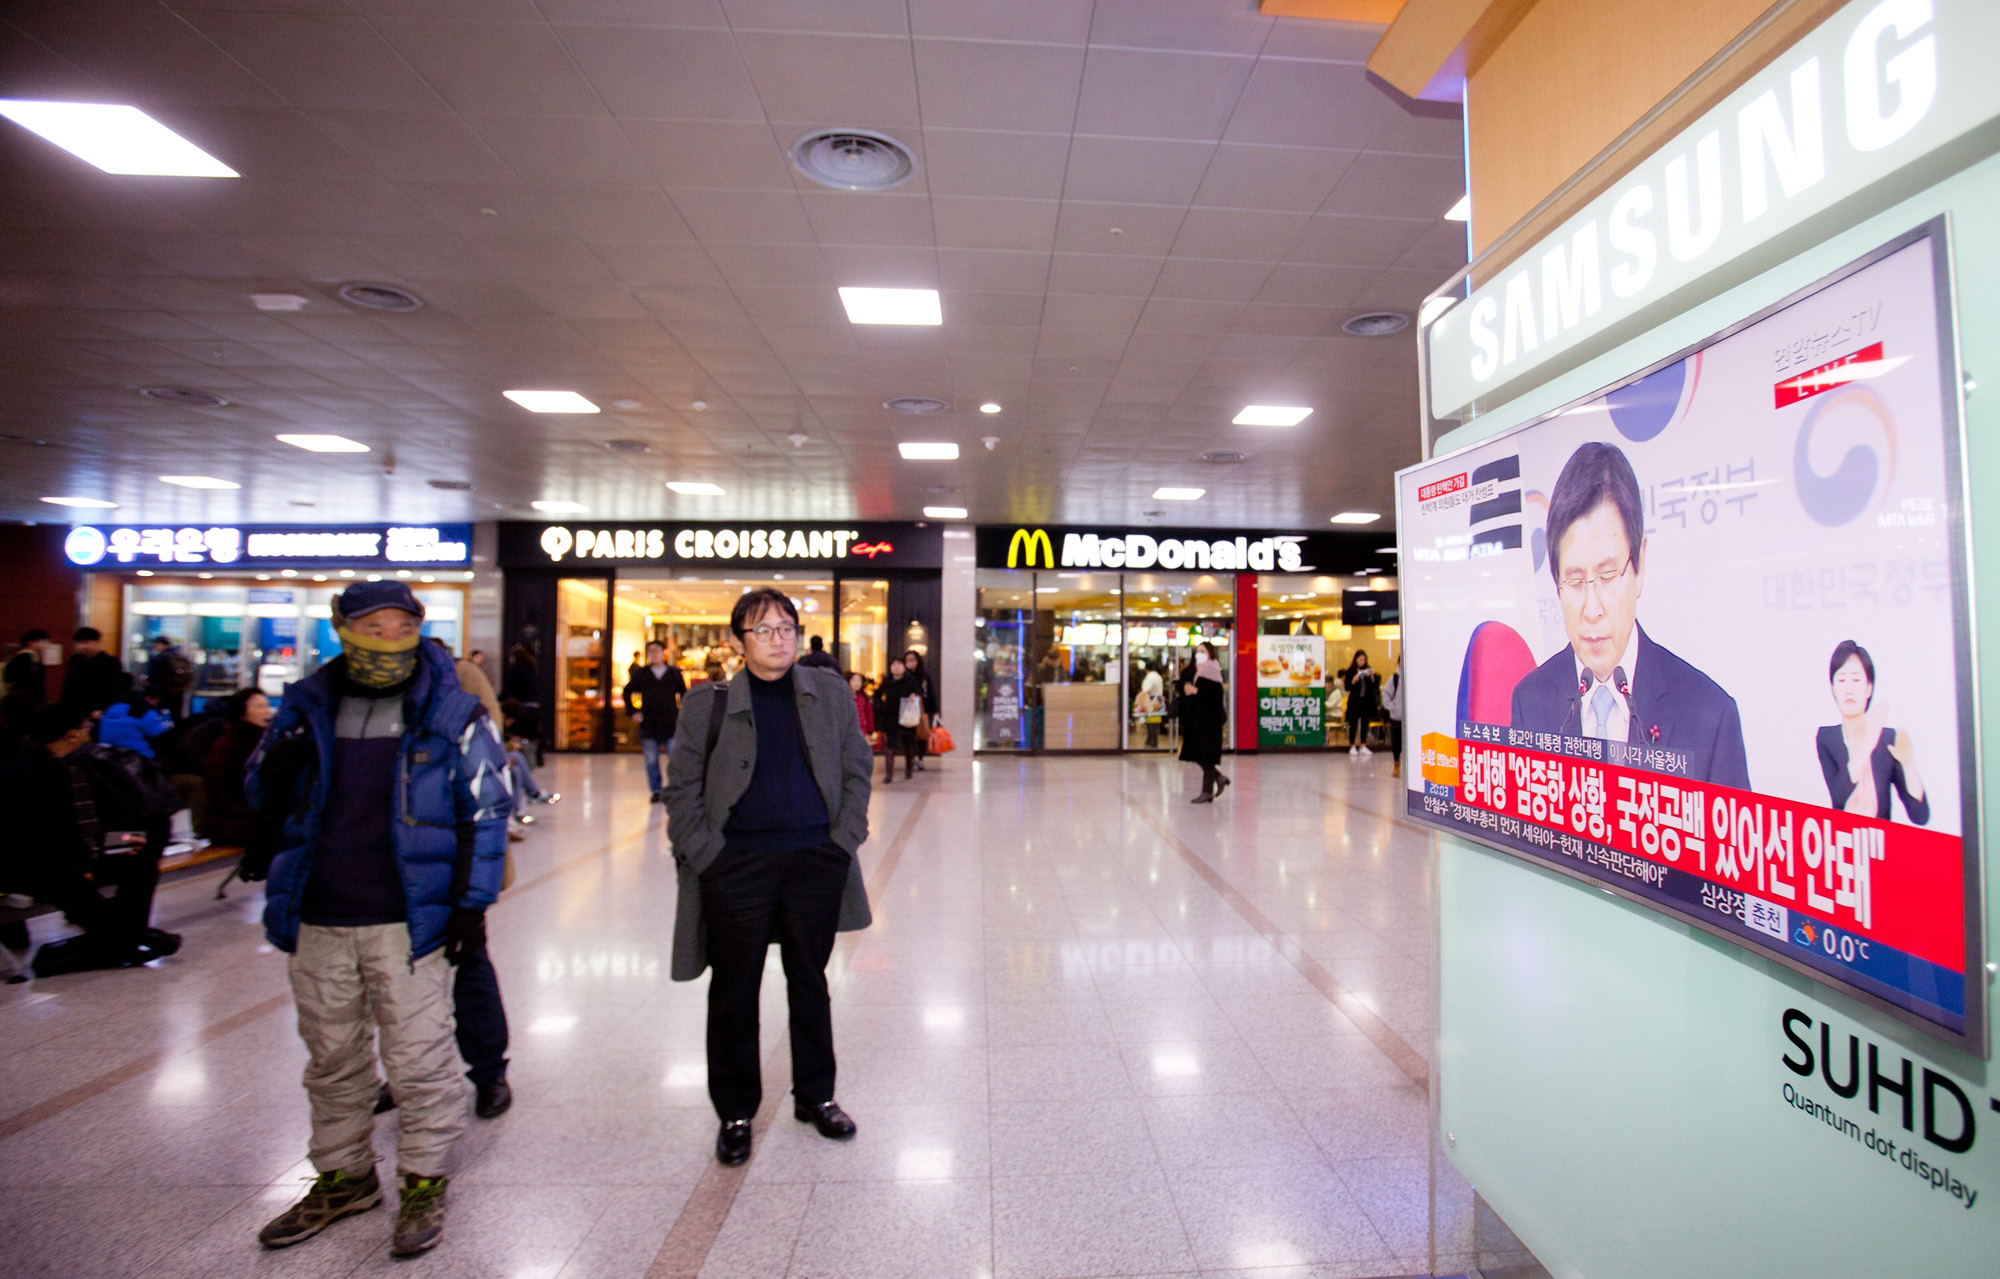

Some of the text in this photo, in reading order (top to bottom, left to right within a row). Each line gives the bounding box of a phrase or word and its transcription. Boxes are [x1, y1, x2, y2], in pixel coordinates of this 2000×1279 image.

[1470, 0, 1937, 382] SAMSUNG
[1775, 301, 1882, 372] 연합뉴스TV
[1475, 484, 1494, 500] 찬성표
[575, 529, 664, 559] PARIS
[675, 529, 853, 559] CROISSANT
[1061, 533, 1302, 571] McDonald's
[1260, 697, 1320, 715] 하루종일
[1260, 716, 1320, 731] 맥런치 가격!
[1463, 723, 1602, 760] 뉴스속보 황교안 대통령 권한대행
[1610, 744, 1687, 774] 이 시각 서울청사
[1424, 795, 1449, 815] 안철수
[1500, 816, 1520, 838] 먼저
[1462, 745, 1506, 810] 황대행
[1568, 766, 1612, 845] 상황,
[1617, 776, 1705, 871] 국정공백
[1712, 796, 1795, 900] 있어선
[1752, 902, 1781, 934] 춘천
[1782, 1008, 1976, 1154] SUHD
[1782, 1083, 1977, 1209] Quantum dot display
